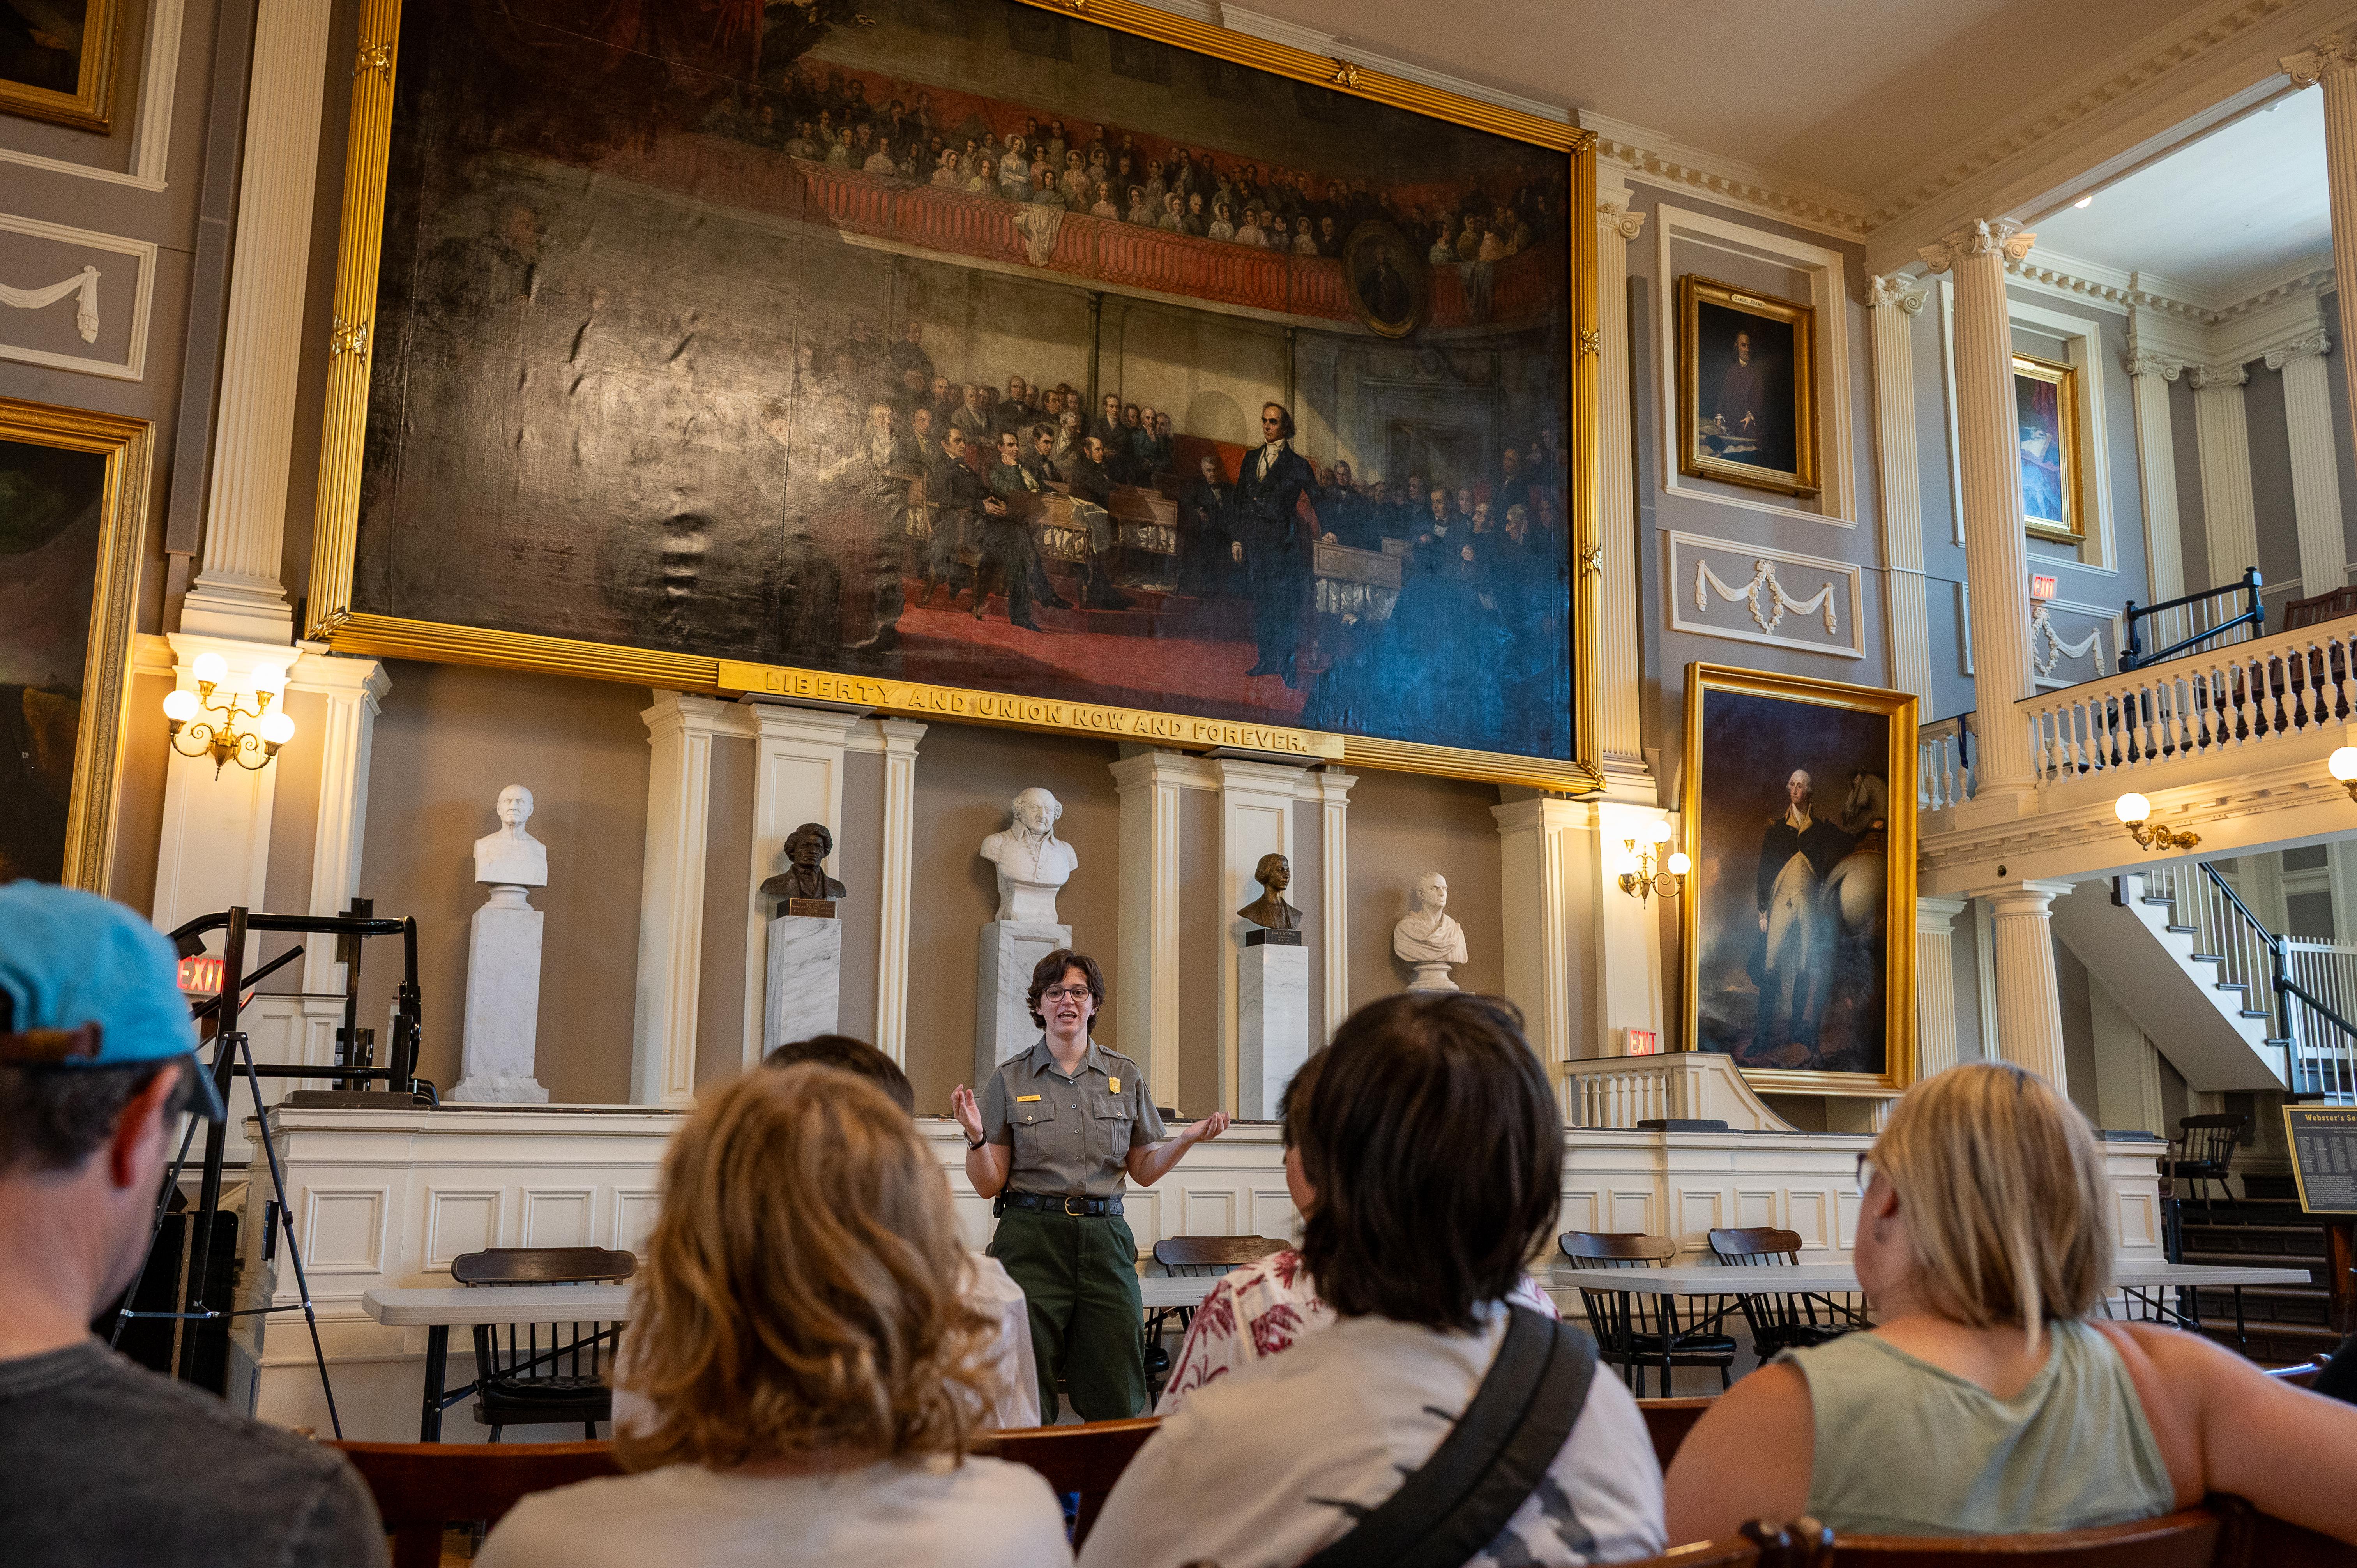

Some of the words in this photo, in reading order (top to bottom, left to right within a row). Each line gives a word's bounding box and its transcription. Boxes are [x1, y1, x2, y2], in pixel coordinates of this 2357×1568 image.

[2034, 577, 2055, 599] EXIT
[766, 671, 899, 704] LIBERTY
[909, 689, 966, 712] AND
[979, 696, 1062, 723] UNION
[1074, 709, 1125, 730] NOW
[1134, 716, 1182, 737] AND
[1194, 722, 1307, 752] FOREVER.
[177, 957, 224, 992] EXIT
[1631, 1030, 1656, 1054] EXIT
